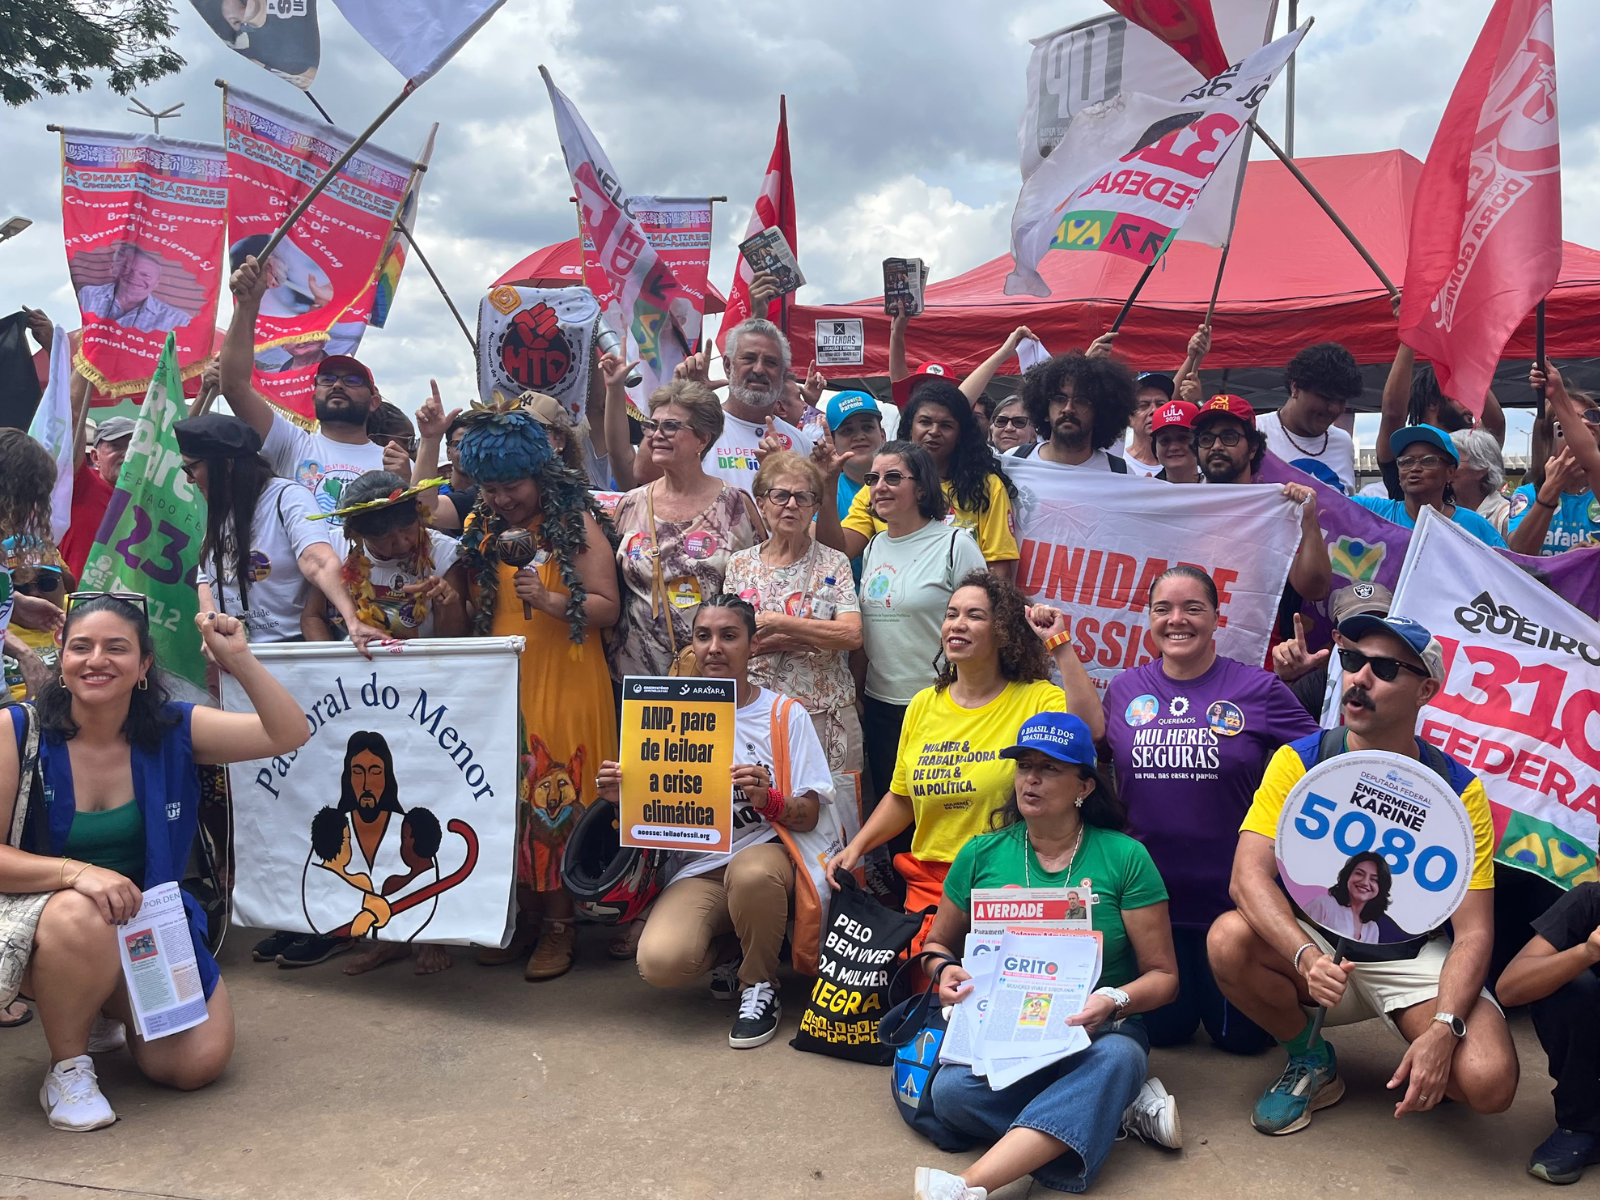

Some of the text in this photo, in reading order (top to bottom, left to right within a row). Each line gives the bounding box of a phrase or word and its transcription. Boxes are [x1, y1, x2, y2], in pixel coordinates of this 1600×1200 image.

[66, 167, 138, 182] ROMARIA
[151, 177, 226, 198] MÁRTIRES
[65, 196, 224, 227] Caravana da Esperança
[107, 212, 178, 233] Brasília-DF
[80, 223, 136, 243] Bernard
[308, 206, 381, 240] Esperança
[312, 238, 344, 268] Stang
[127, 334, 145, 343] na
[504, 345, 568, 386] MTD
[260, 374, 310, 387] Presente
[1163, 408, 1184, 418] LULA
[717, 448, 732, 456] EU
[1544, 528, 1585, 547] afael
[1015, 538, 1239, 628] UNIDAE
[692, 686, 725, 694] ARAYARA
[640, 706, 716, 736] ANP, pare
[1158, 717, 1196, 726] QUEREMOS
[256, 672, 494, 802] Pasoral do Menor
[1022, 734, 1069, 746] BRASILEIROS
[1026, 726, 1048, 735] BRASIL
[1050, 726, 1056, 735] É
[1057, 728, 1075, 740] DOS
[1133, 728, 1218, 746] MULHERES
[640, 738, 714, 763] de leiloar
[922, 740, 970, 754] MULHER &
[1132, 746, 1220, 769] SEGURAS
[650, 769, 703, 794] a crise
[912, 766, 962, 781] DE LUTA &
[912, 780, 977, 797] NA POLÍTICA.
[1360, 771, 1432, 806] DEPUTADA FEDERAL
[1356, 782, 1426, 818] ENFERMEIRA
[642, 799, 714, 826] climática
[1350, 791, 1425, 832] KARINE
[1294, 792, 1458, 892] 5080
[144, 897, 162, 909] POR
[976, 902, 1044, 918] A VERDADE
[834, 913, 873, 942] PELO
[974, 928, 1005, 936] Pagament
[826, 932, 896, 964] BEM VIVER
[818, 954, 888, 987] DA MULHER
[1004, 957, 1059, 976] GRITO
